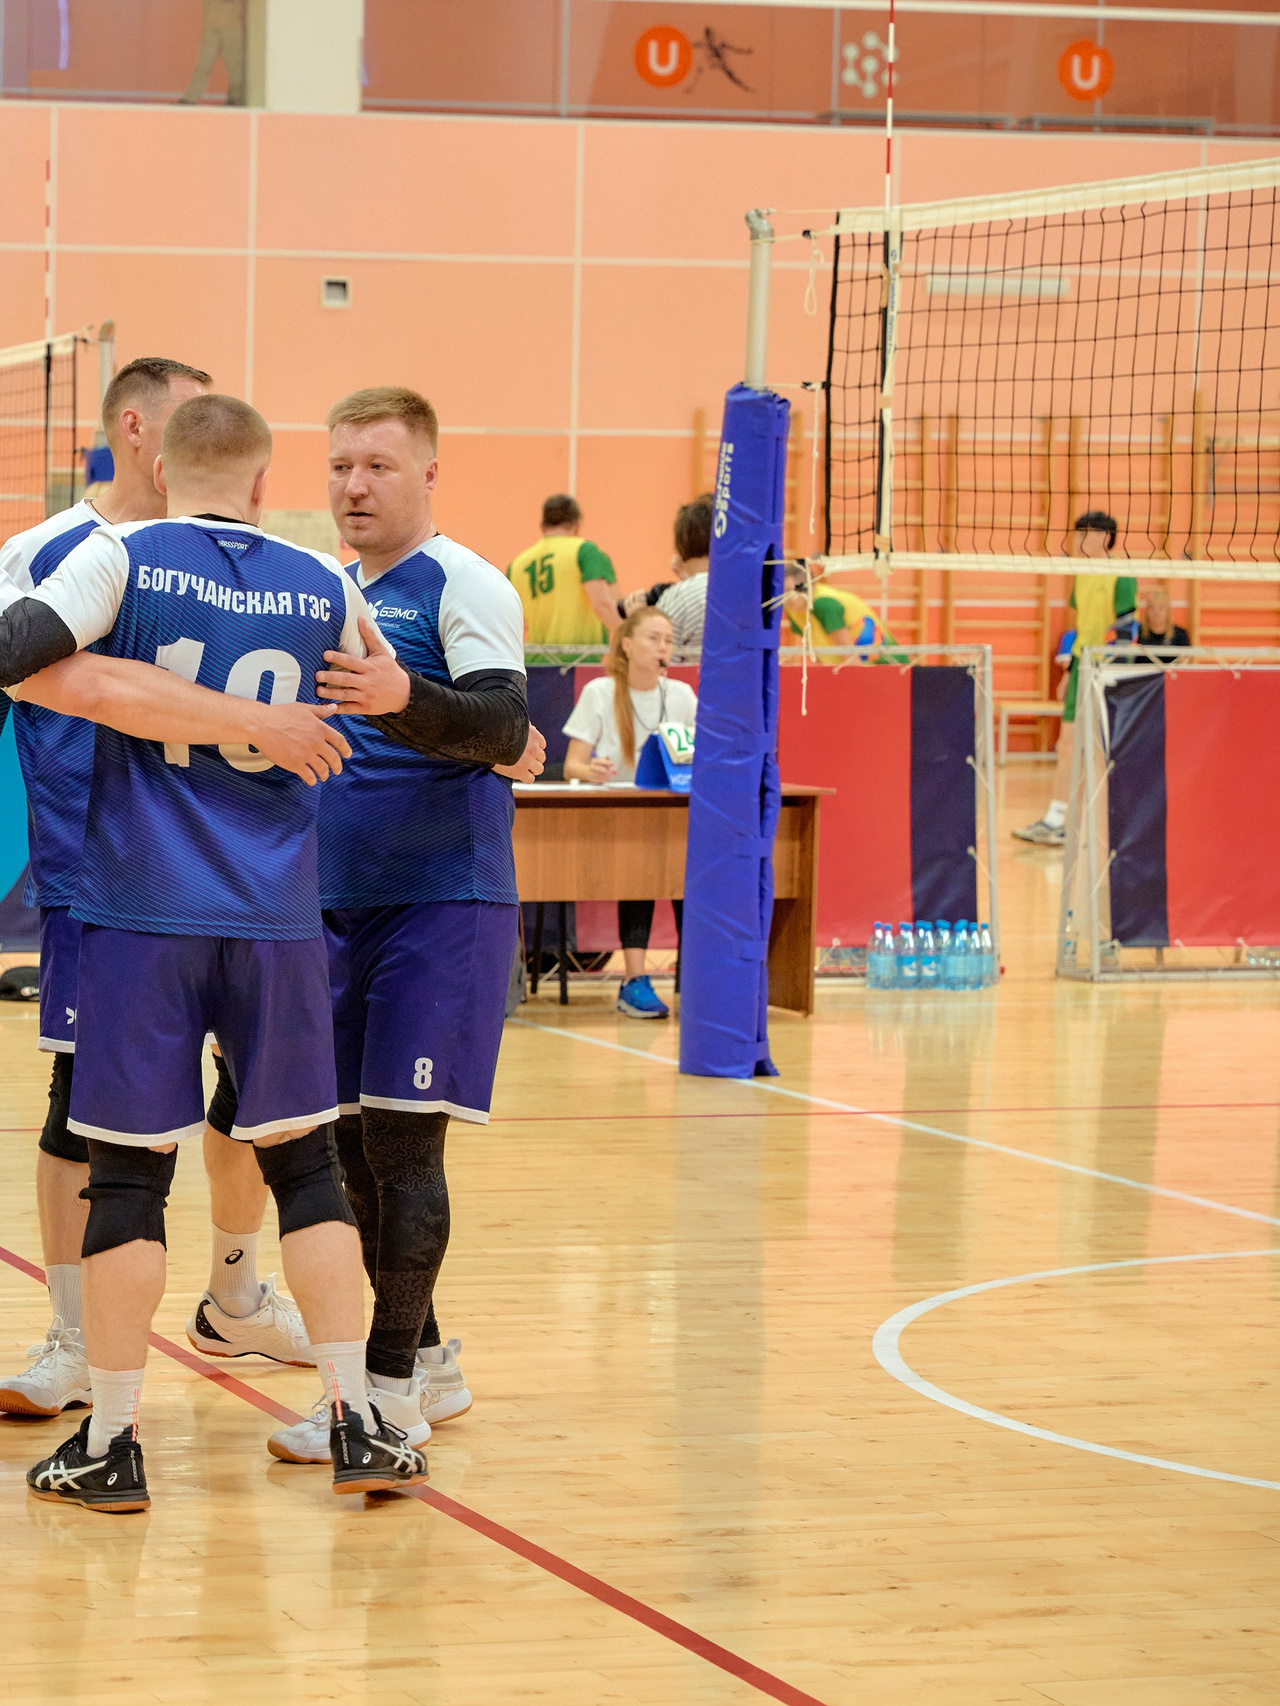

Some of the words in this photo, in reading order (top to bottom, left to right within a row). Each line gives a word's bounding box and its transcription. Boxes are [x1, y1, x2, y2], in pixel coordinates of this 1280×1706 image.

[648, 39, 678, 76] U
[1072, 54, 1100, 90] U
[136, 565, 294, 615] БОГУЧАНСКАЯ
[298, 592, 331, 622] ГЭС
[524, 553, 554, 599] 15
[413, 1056, 433, 1090] 8
